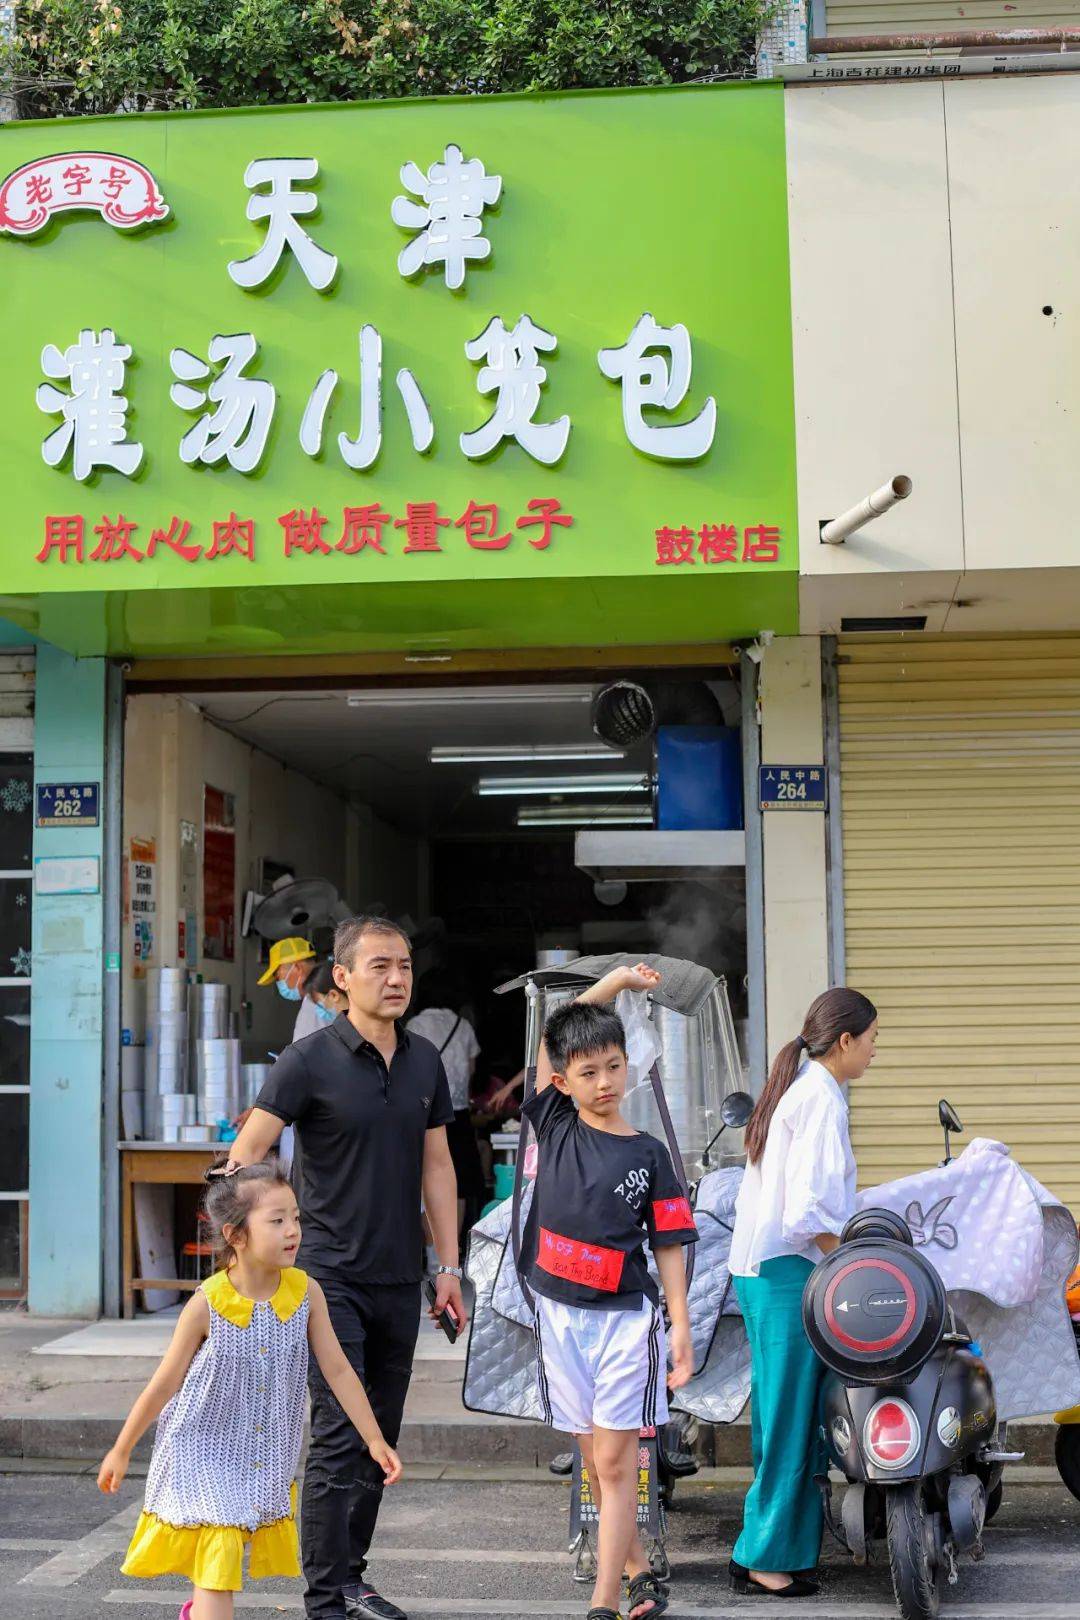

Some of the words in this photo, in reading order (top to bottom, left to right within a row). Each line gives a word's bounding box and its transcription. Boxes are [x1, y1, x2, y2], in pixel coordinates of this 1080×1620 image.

[25, 163, 132, 205] 老字号
[227, 143, 503, 290] 天津
[36, 312, 717, 481] 灌汤小笼包
[36, 511, 256, 564] 用放心肉
[277, 498, 573, 557] 做质量包子
[654, 523, 780, 566] 鼓楼店
[54, 800, 82, 817] 262
[777, 782, 807, 800] 264
